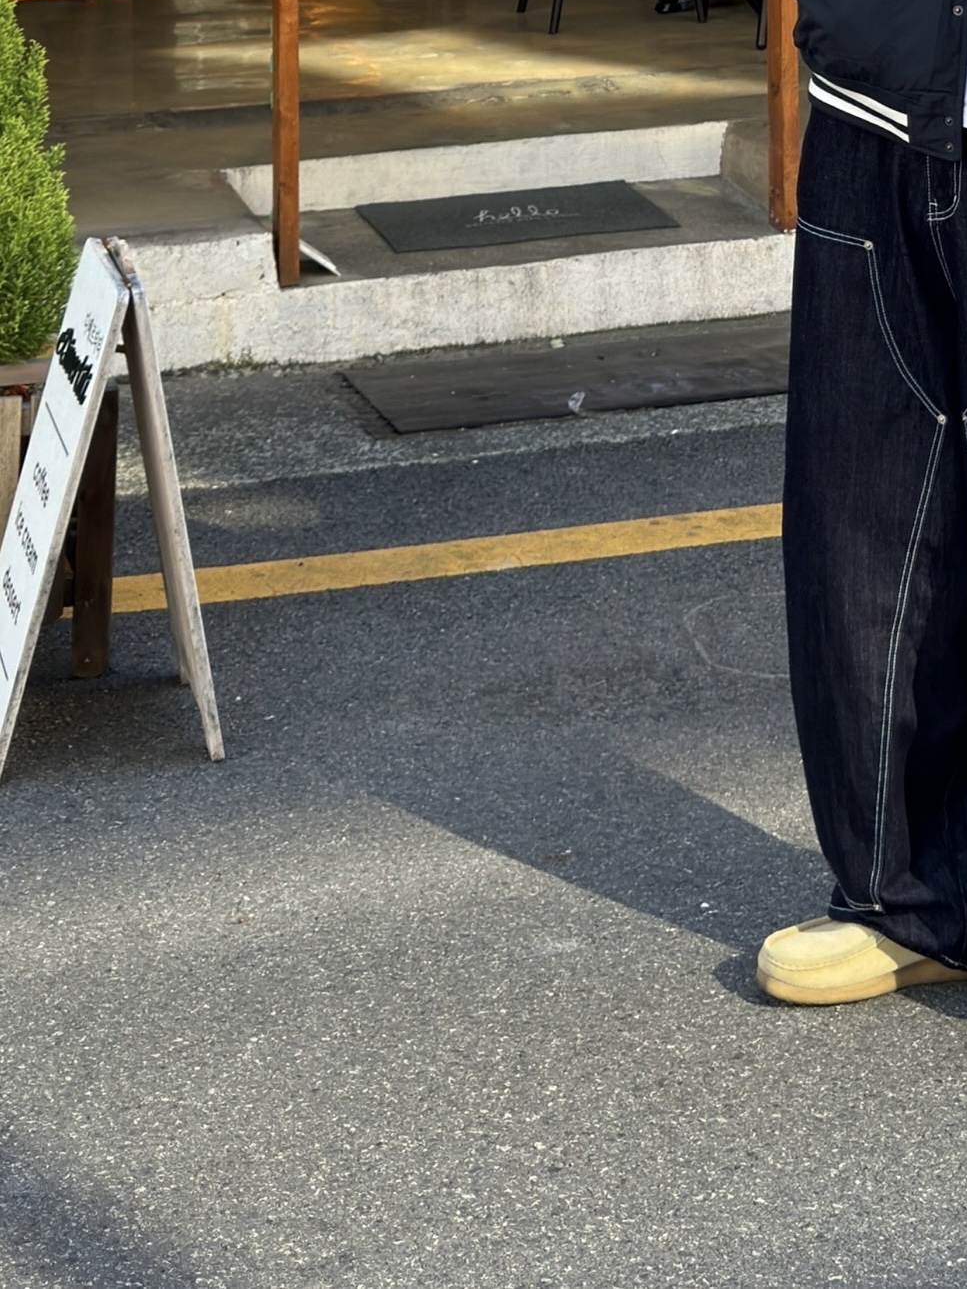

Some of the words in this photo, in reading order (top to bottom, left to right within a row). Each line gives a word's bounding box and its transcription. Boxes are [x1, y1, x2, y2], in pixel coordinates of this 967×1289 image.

[33, 462, 50, 508] coffee
[15, 500, 25, 537] ice
[21, 526, 38, 576] cream
[3, 566, 22, 626] dessert
